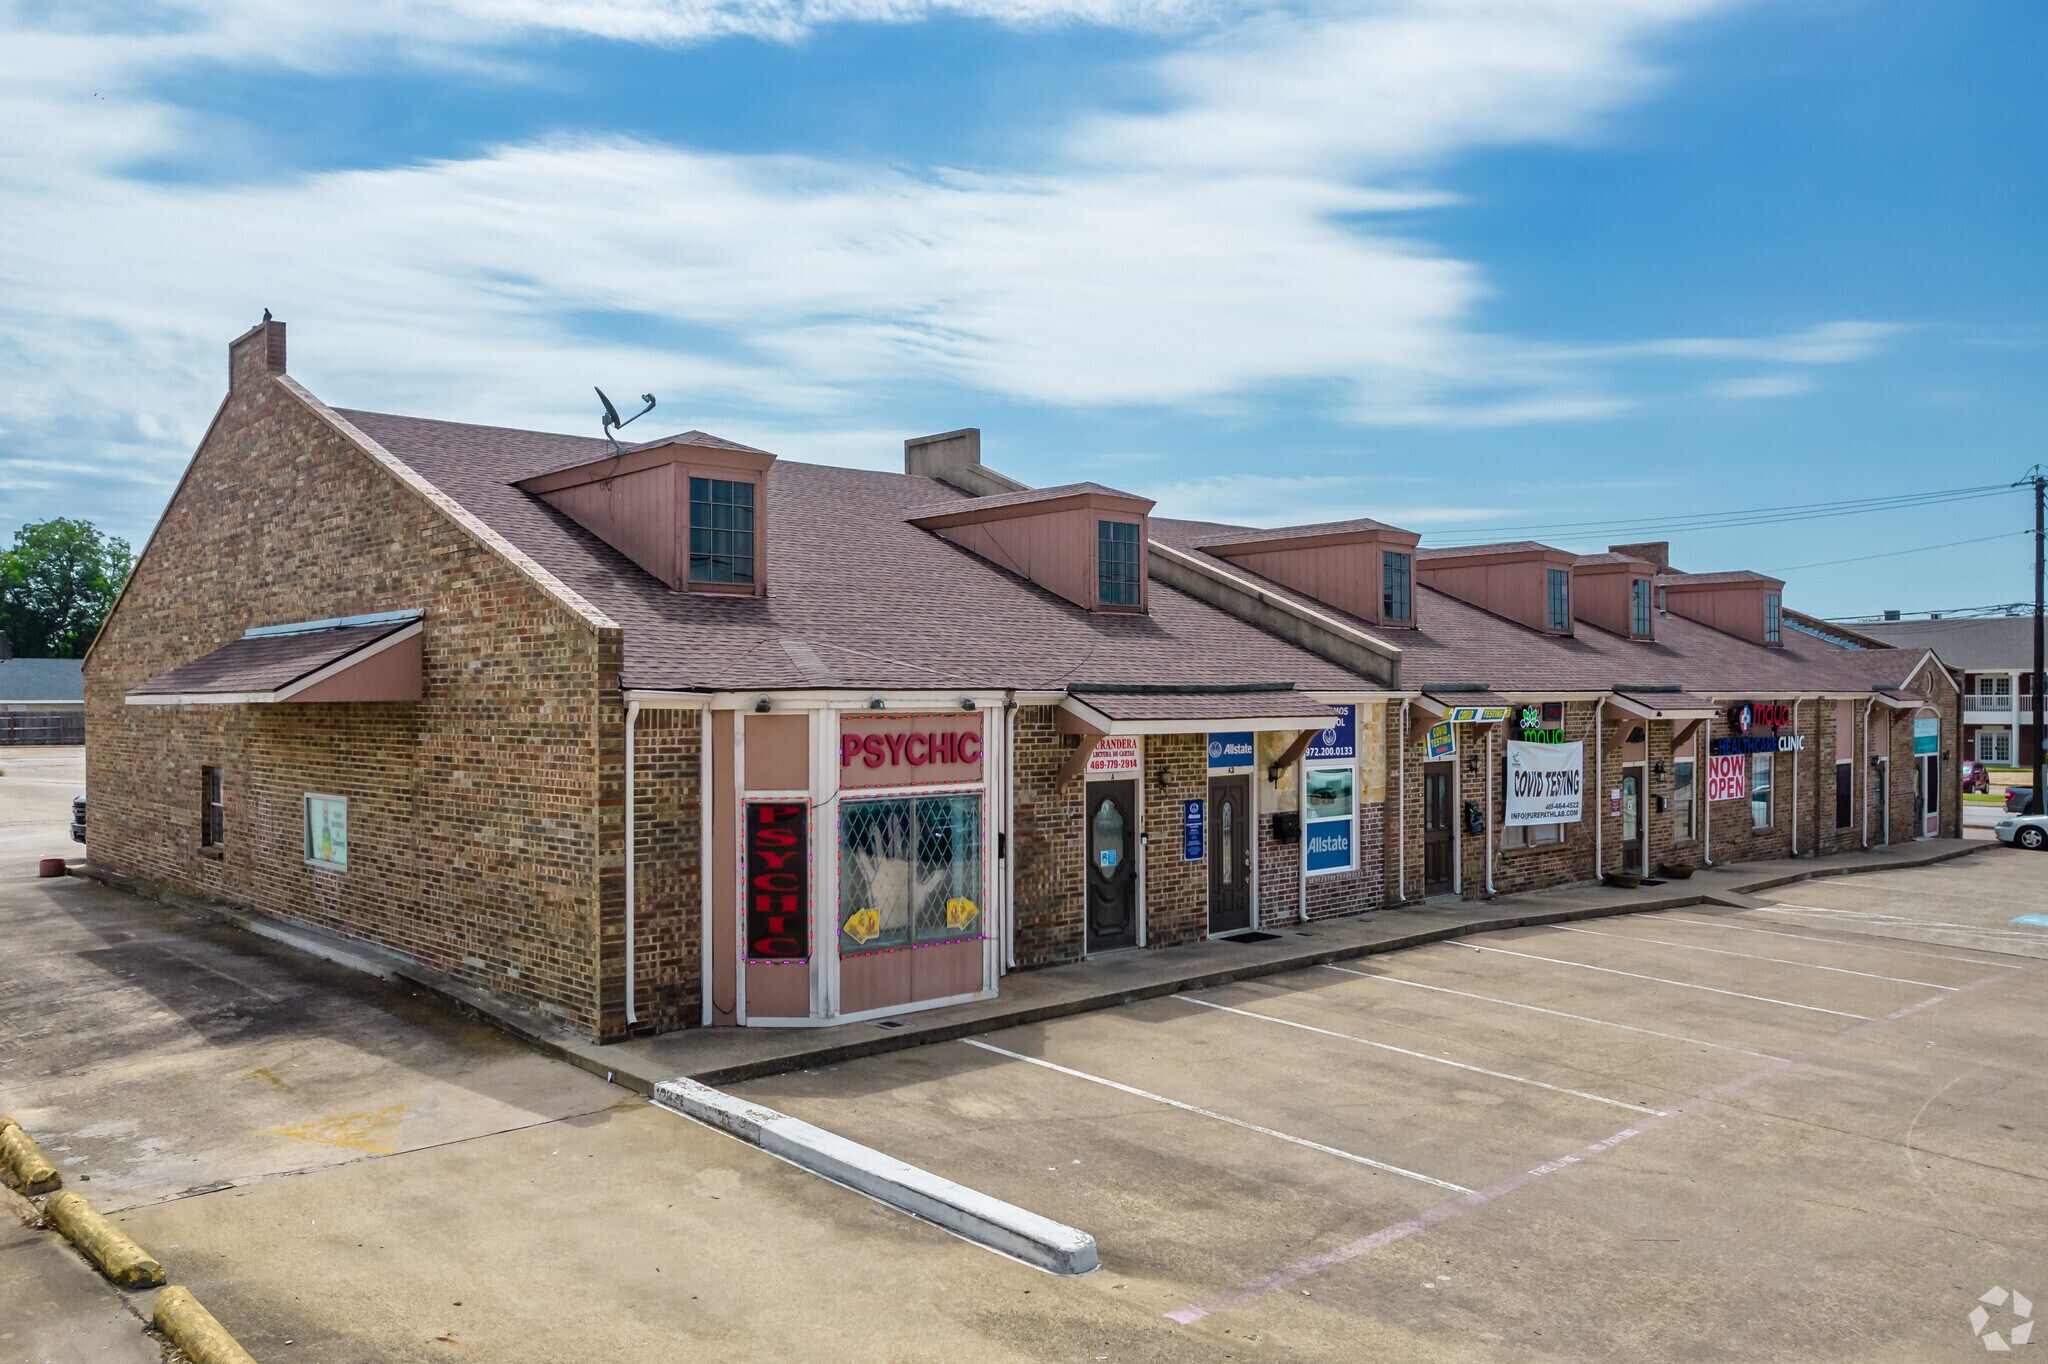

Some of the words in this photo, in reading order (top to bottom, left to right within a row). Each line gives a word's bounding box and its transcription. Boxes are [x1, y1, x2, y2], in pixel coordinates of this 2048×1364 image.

[1458, 710, 1474, 719] COVID
[1484, 709, 1503, 718] TESTING
[1433, 725, 1447, 737] COVID
[1095, 738, 1137, 750] URANDERA
[1223, 743, 1253, 754] Allstate
[1430, 734, 1451, 748] TESTING
[1718, 737, 1777, 755] HEALTHCARE
[1778, 735, 1805, 751] CLINIC
[841, 731, 981, 768] PSYCHIC
[1305, 746, 1353, 756] 972.200.0133
[1090, 759, 1137, 769] 469-779-2914
[1709, 756, 1744, 778] NOW
[1514, 770, 1543, 797] COVID
[1545, 769, 1579, 797] TESTING
[1708, 776, 1744, 800] OPEN
[1307, 835, 1348, 854] Allstate
[752, 806, 801, 956] PSYCHIC
